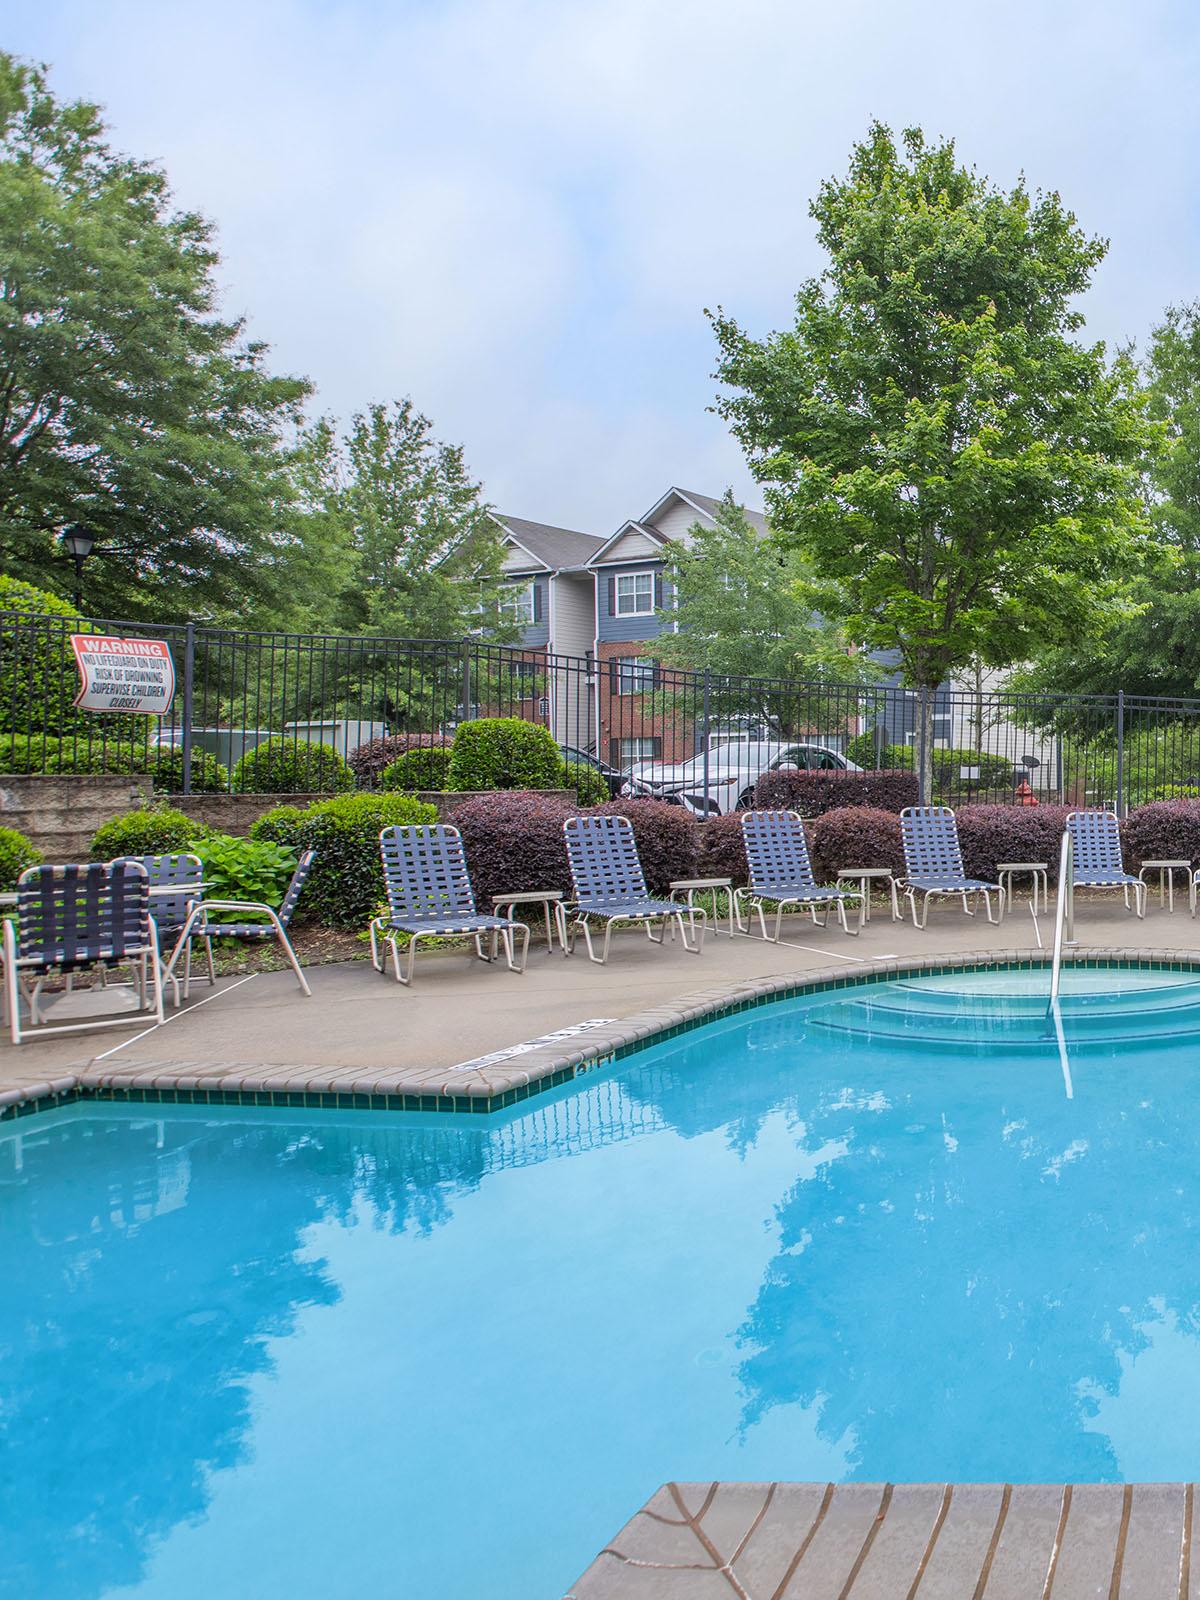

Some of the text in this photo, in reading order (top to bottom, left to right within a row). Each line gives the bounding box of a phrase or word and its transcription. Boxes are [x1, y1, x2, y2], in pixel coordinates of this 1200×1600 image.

[83, 640, 161, 656] WARNING
[83, 654, 168, 670] NO LIFEGUARD ON DUTY
[95, 668, 163, 683] RISK OF DROWNING
[91, 682, 166, 697] SUPERVISE CHILDREN
[109, 698, 142, 708] CLOSELY
